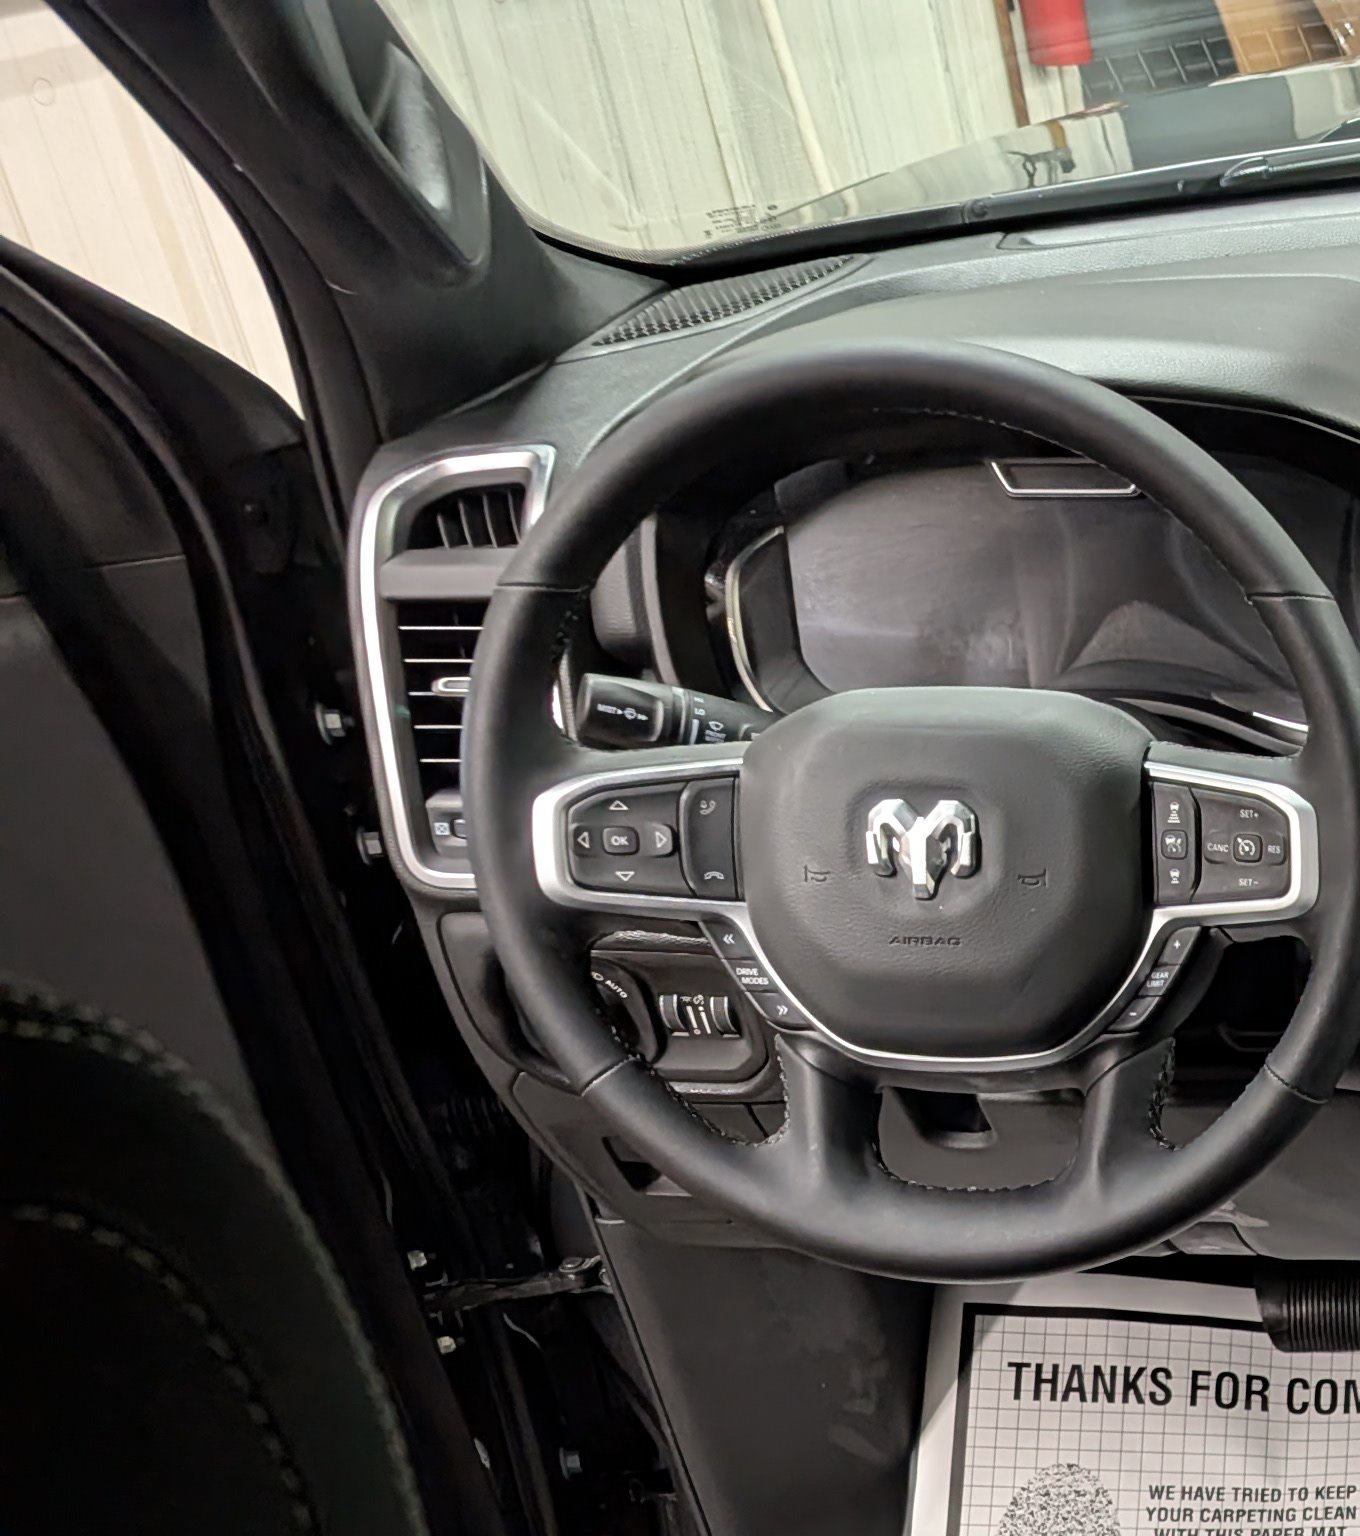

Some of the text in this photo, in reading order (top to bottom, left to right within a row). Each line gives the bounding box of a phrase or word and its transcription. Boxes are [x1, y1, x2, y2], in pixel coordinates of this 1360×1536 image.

[611, 836, 629, 846] OK
[1207, 844, 1229, 853] CANC
[1268, 845, 1281, 854] RES
[889, 936, 961, 946] AIRBAG
[736, 967, 758, 976] DRIVE
[1151, 972, 1169, 980] GEAR
[741, 976, 769, 985] MODES
[604, 979, 627, 999] AUTO
[1007, 1361, 1173, 1406] THANKS
[1189, 1369, 1270, 1412] FOR
[1149, 1485, 1357, 1503] WE HAVE TRIED TO KEEP
[1146, 1506, 1357, 1523] YOUR CARPETING CLEAN
